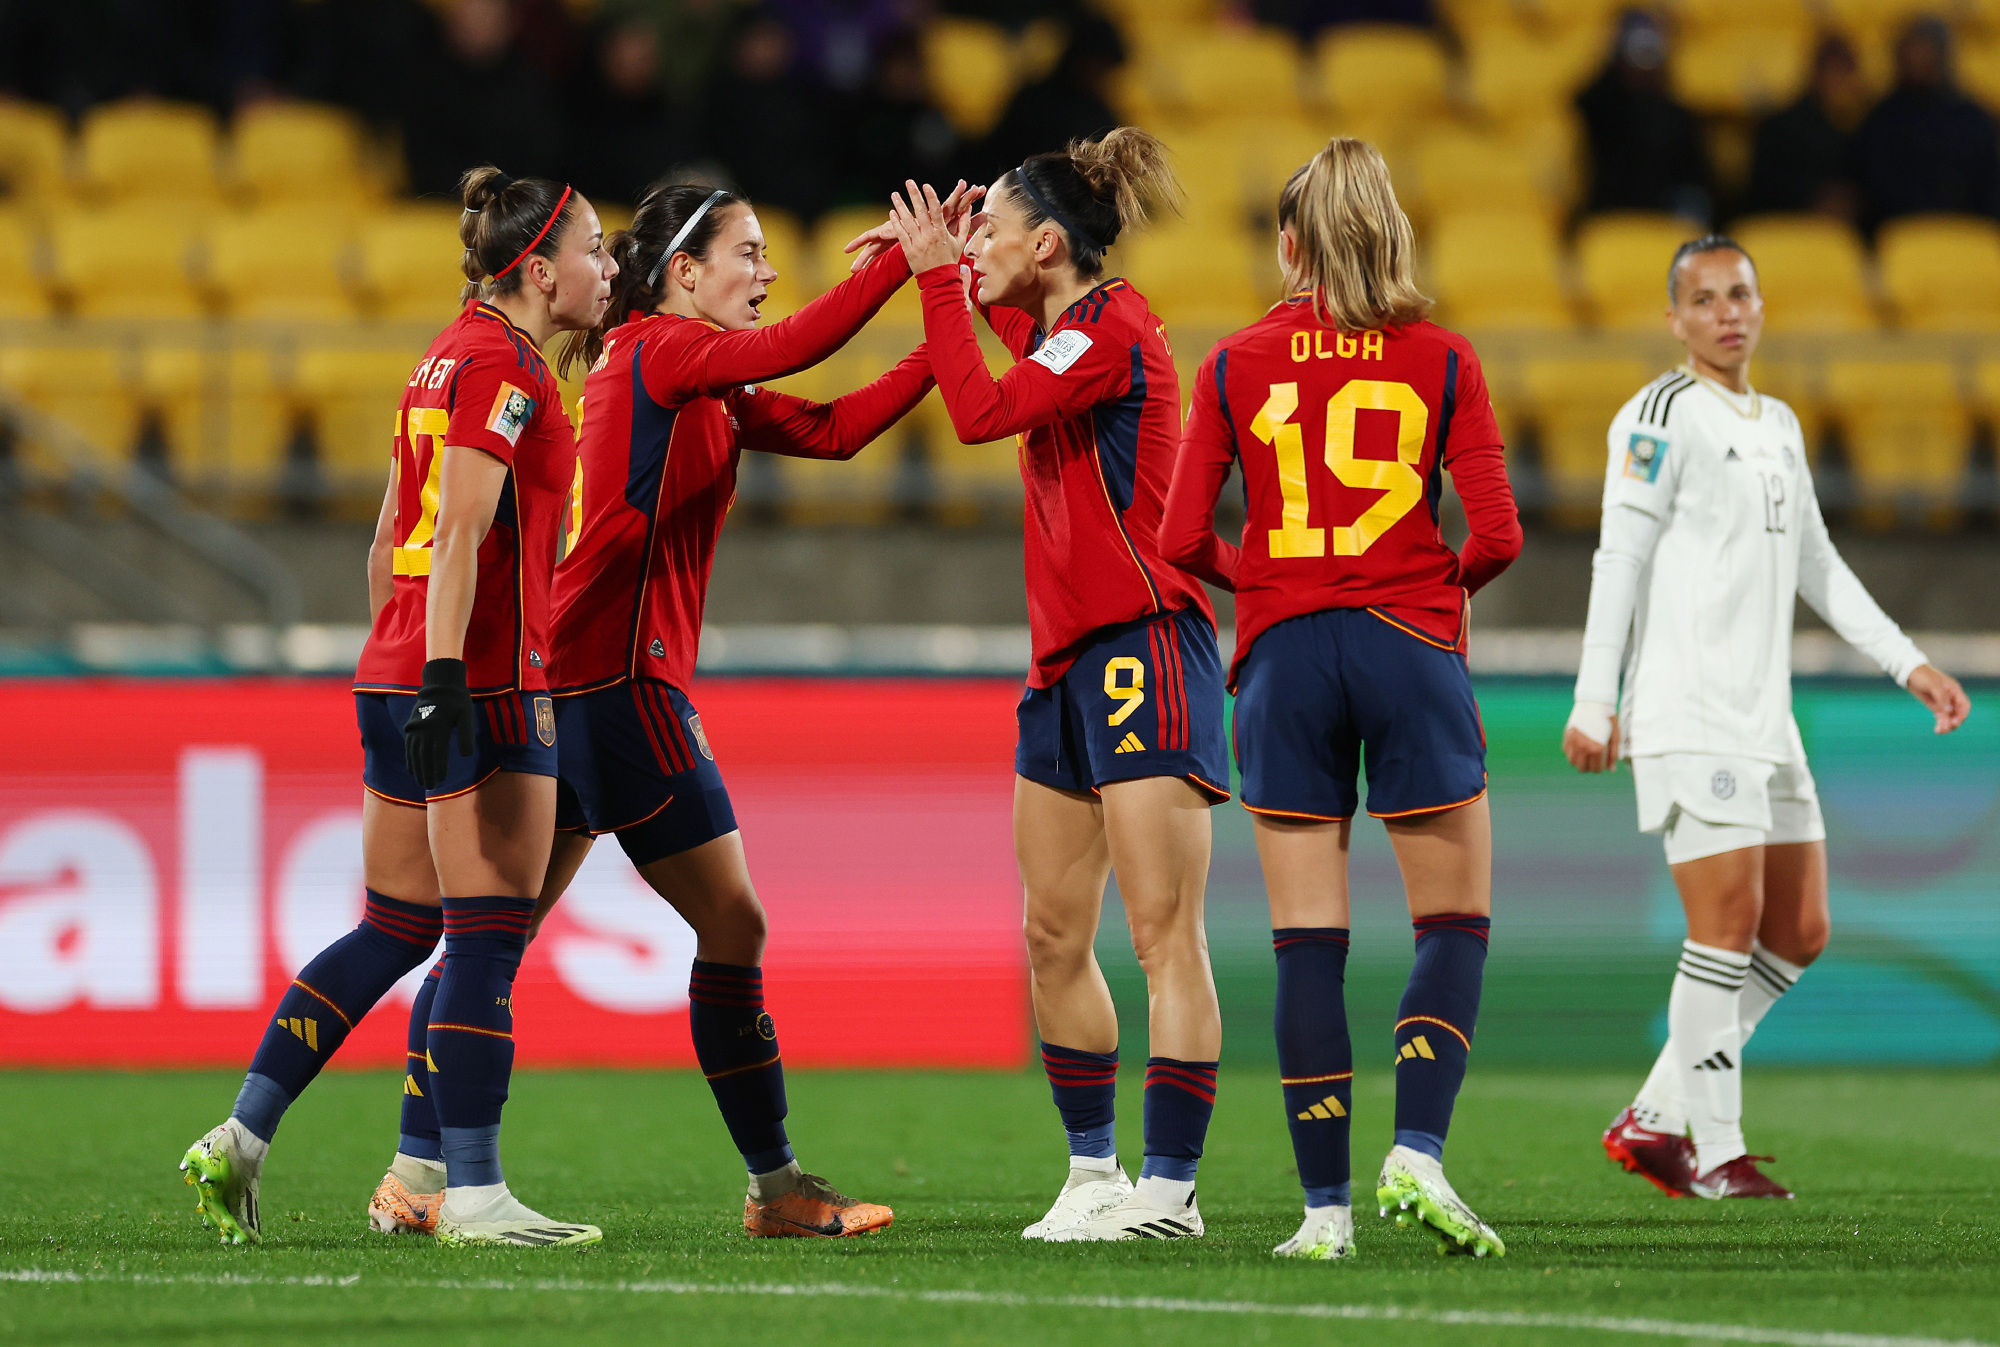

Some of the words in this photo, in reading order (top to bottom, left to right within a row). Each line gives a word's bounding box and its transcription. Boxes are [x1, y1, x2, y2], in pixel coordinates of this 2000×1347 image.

[1291, 330, 1384, 362] OLGA
[1250, 379, 1428, 558] 19
[1757, 471, 1786, 533] 12
[1103, 656, 1145, 727] 9
